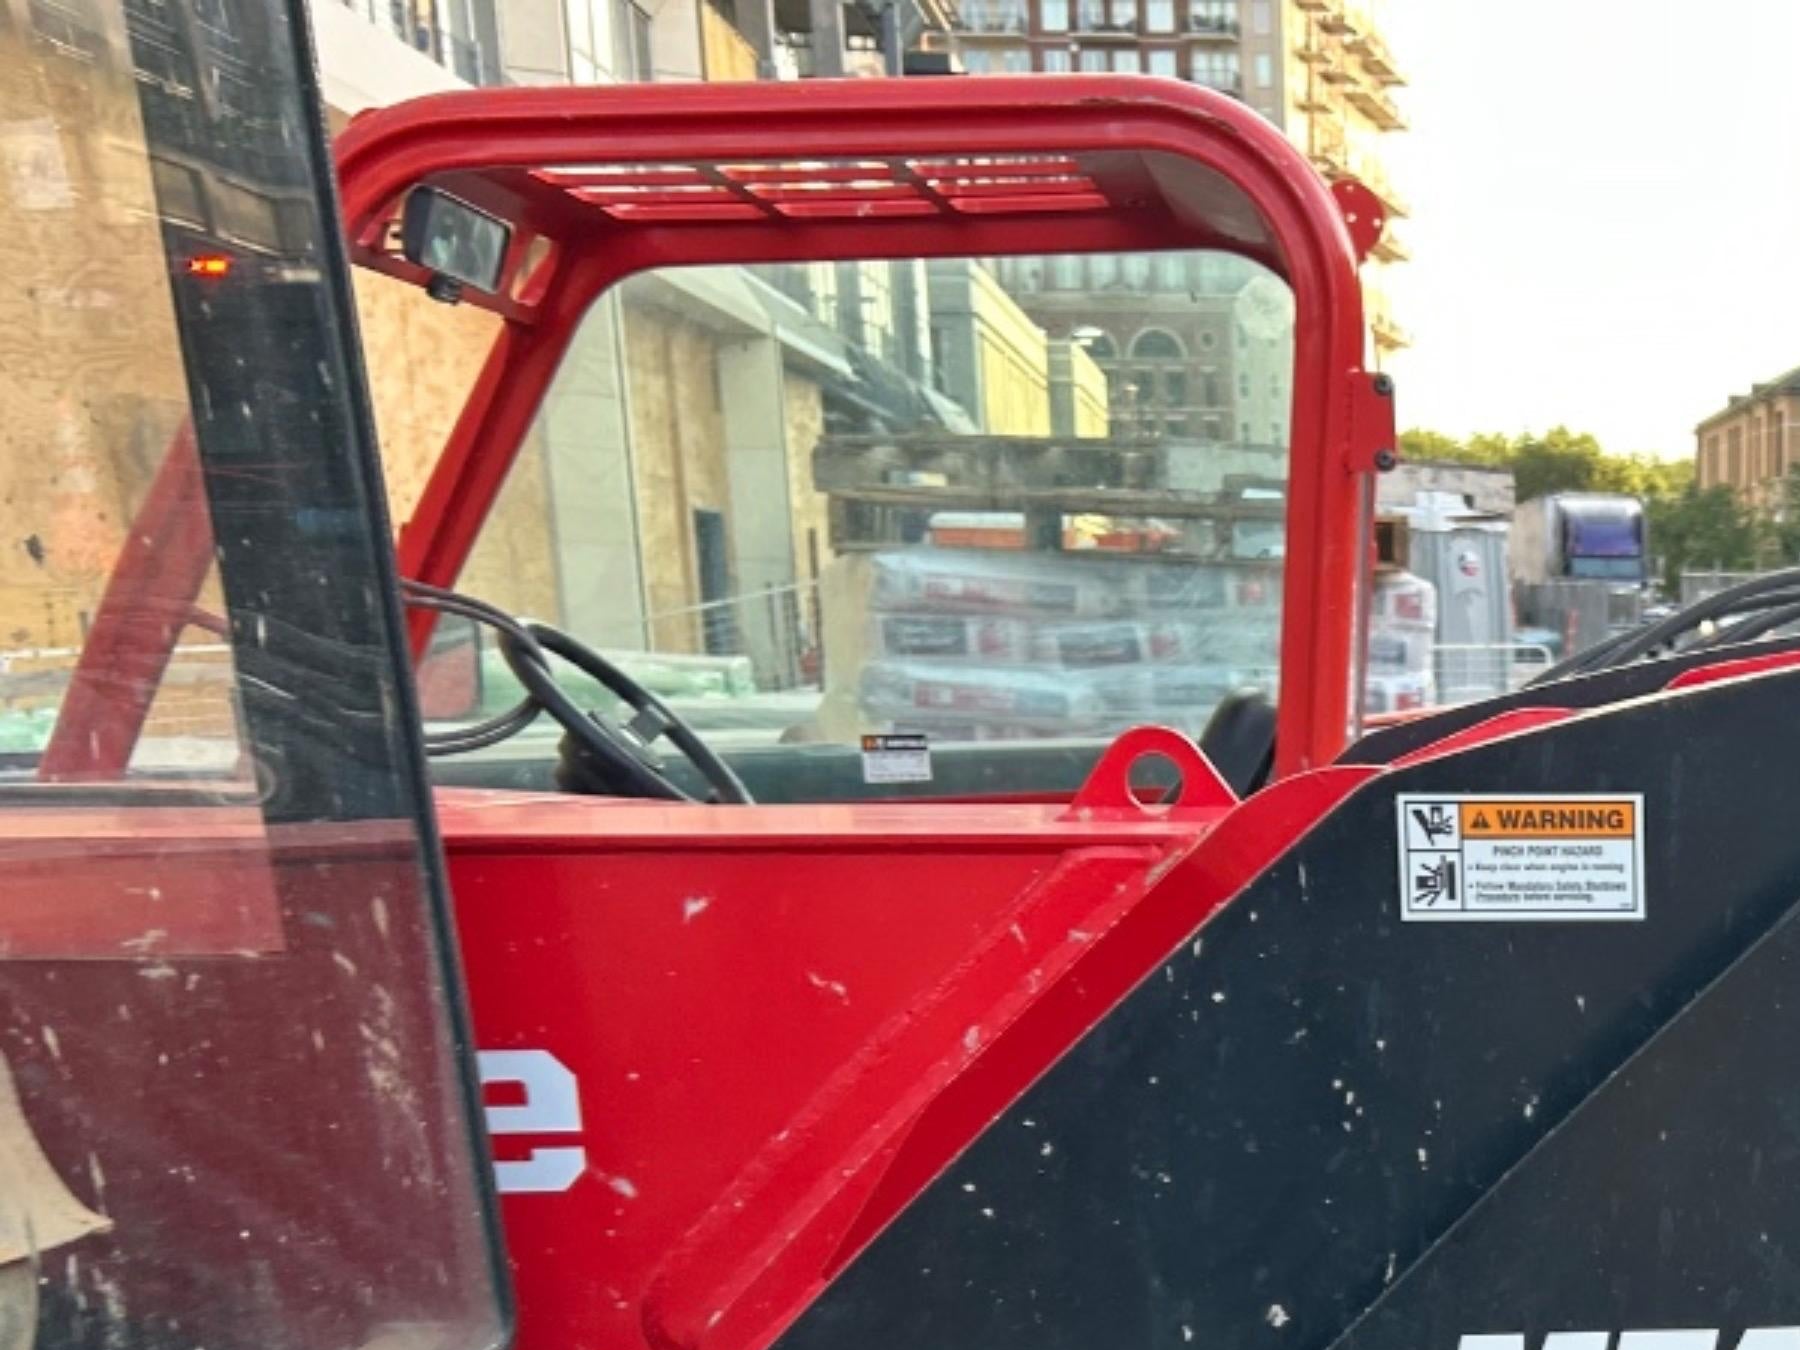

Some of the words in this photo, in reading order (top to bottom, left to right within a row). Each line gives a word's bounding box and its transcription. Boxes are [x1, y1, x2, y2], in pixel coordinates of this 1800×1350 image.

[1496, 809, 1625, 830] WARNING
[1493, 845, 1525, 856] PINCH
[1527, 845, 1558, 856] POINT
[1562, 845, 1603, 856] HAZARD
